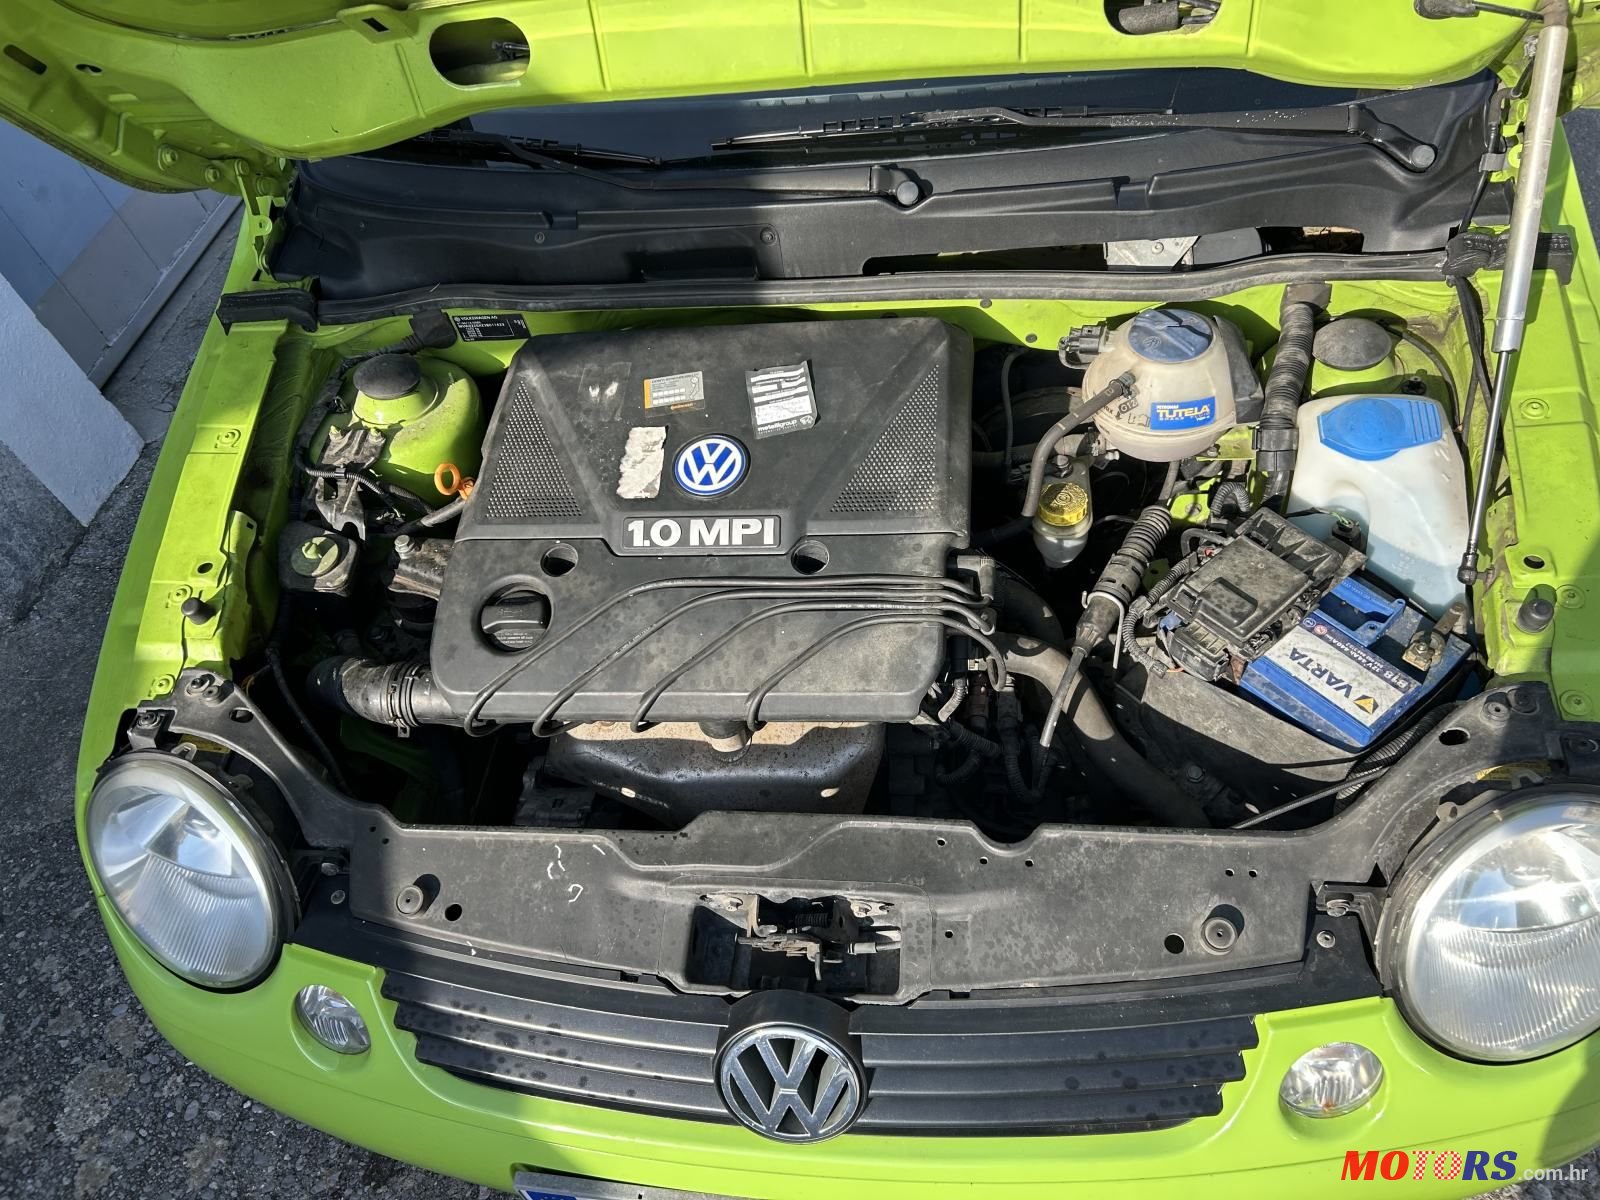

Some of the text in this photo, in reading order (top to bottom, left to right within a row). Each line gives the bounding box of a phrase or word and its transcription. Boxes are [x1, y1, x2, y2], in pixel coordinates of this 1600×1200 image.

[1157, 405, 1210, 418] TUTELA
[627, 518, 775, 547] 1.0 MPI
[1289, 647, 1353, 699] VARTA
